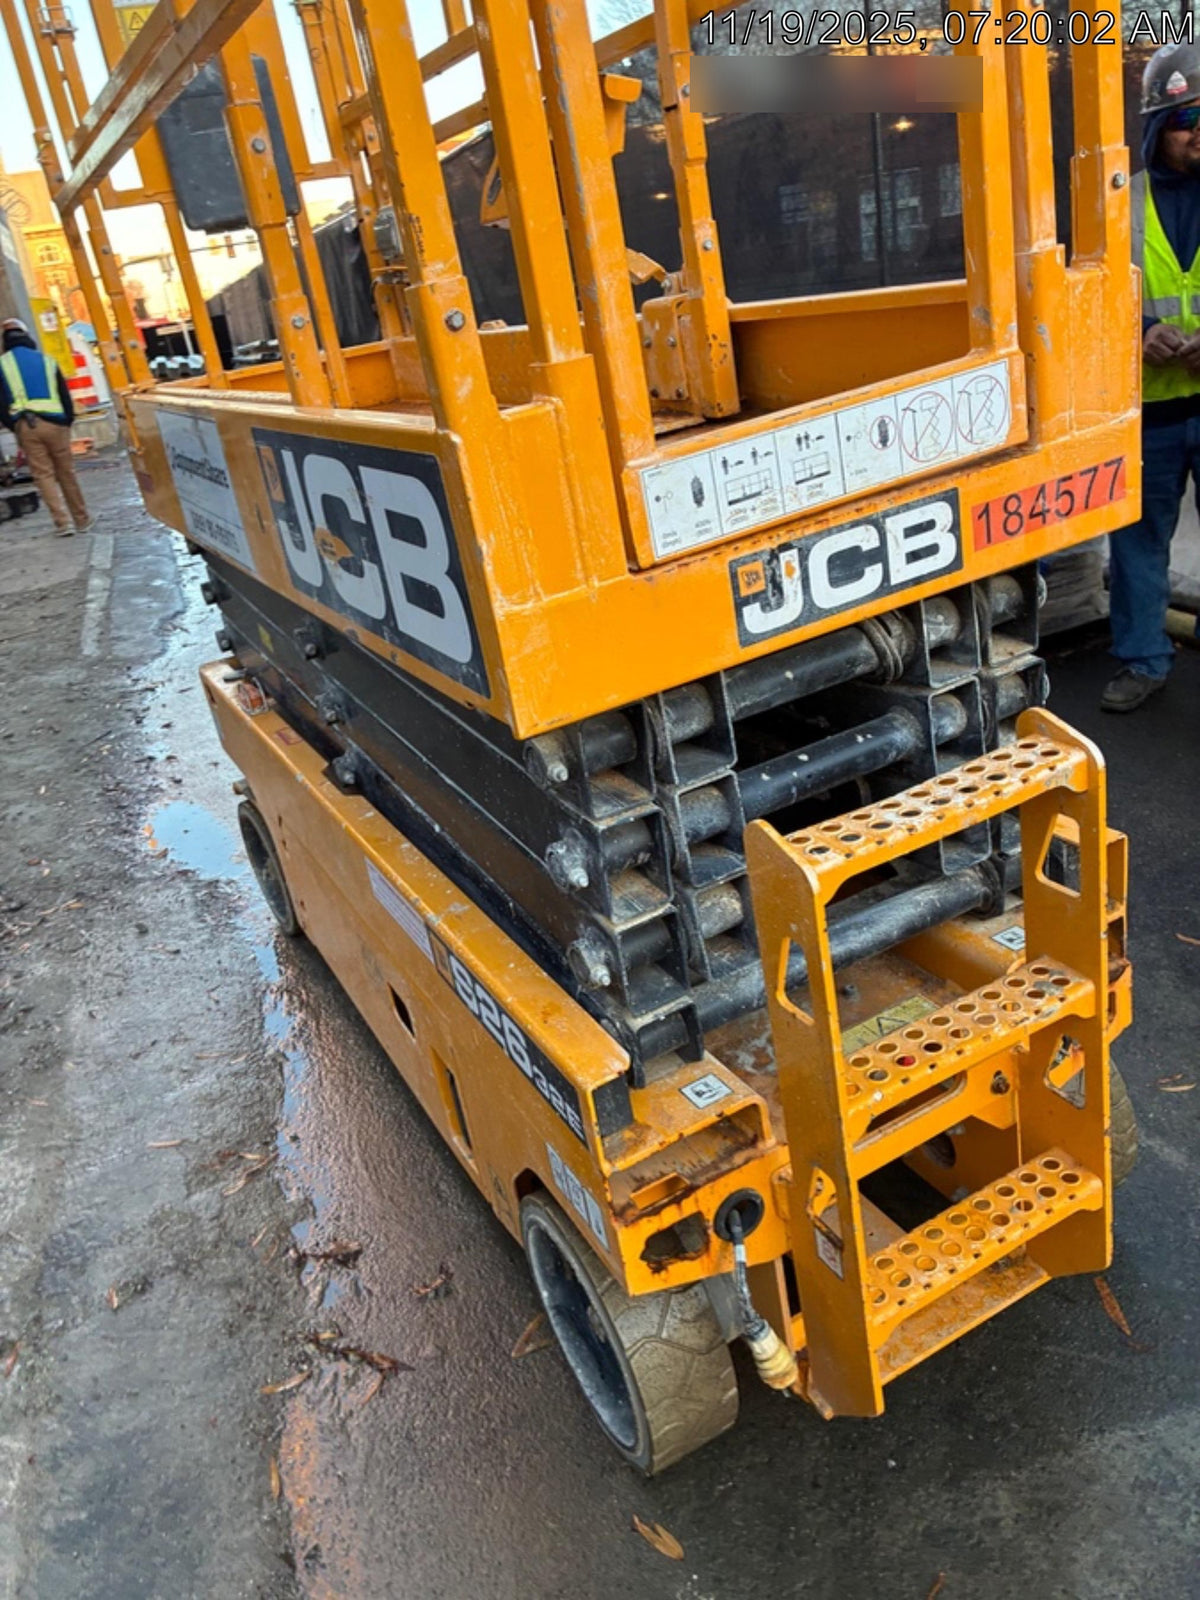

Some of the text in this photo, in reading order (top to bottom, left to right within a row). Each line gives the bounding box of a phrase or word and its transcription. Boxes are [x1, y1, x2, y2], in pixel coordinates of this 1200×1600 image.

[277, 448, 473, 664] JCB
[742, 500, 958, 635] JCB
[976, 456, 1125, 545] 184577
